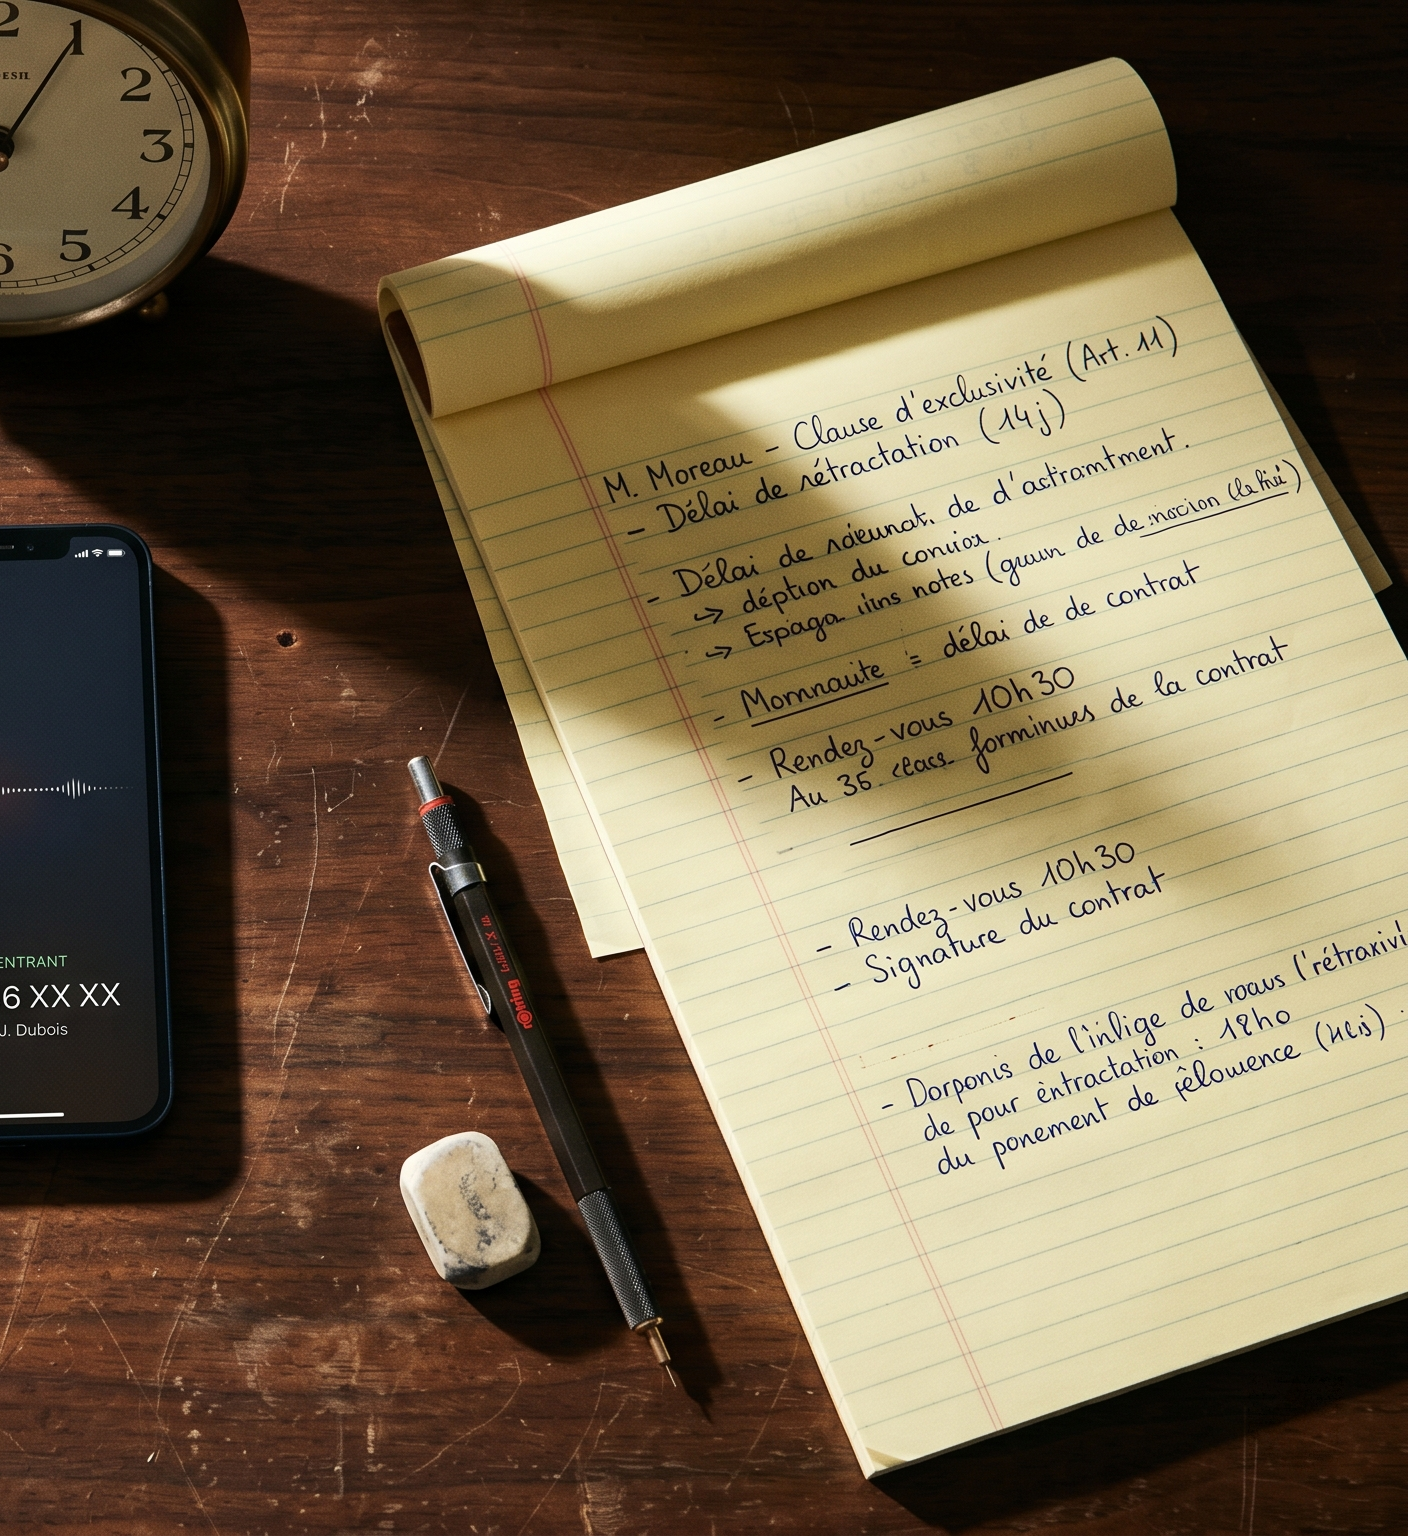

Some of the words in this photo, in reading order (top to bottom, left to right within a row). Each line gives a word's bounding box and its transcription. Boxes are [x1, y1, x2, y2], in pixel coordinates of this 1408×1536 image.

[120, 67, 152, 102] 2
[140, 128, 174, 163] 3
[111, 185, 150, 220] 4
[59, 228, 92, 262] 5
[603, 471, 638, 504] M.
[645, 452, 753, 491] Moreau
[794, 414, 883, 450] Clause
[896, 353, 1053, 423] d'exclusivité
[656, 490, 740, 533] Délai
[756, 476, 789, 504] de
[800, 433, 959, 492] rétractation
[980, 388, 1065, 444] (14j)
[672, 557, 759, 598] Délai
[779, 543, 814, 568] de
[948, 493, 980, 518] de
[851, 558, 889, 583] du
[912, 568, 974, 599] notes
[1077, 525, 1104, 549] de
[1114, 513, 1145, 537] de
[944, 620, 1010, 658] délai
[1023, 609, 1055, 634] de
[1065, 594, 1096, 621] de
[1106, 559, 1200, 608] contrat
[769, 711, 953, 779] Rendez-vous
[790, 785, 829, 812] Au
[1110, 686, 1143, 713] de
[1154, 670, 1186, 697] la
[1196, 635, 1289, 686] contrat
[849, 881, 1023, 947] Rendez-vous
[1041, 842, 1135, 887] 10h30
[865, 928, 1006, 990] Signature
[1019, 907, 1059, 936] du
[1069, 865, 1166, 919] contrat
[0, 1024, 12, 1037] J.
[16, 1022, 69, 1037] Dubois
[29, 983, 71, 1009] XX
[79, 982, 121, 1007] XX
[1029, 1041, 1061, 1070] de
[1180, 989, 1215, 1019] de
[924, 1112, 955, 1141] de
[967, 1096, 1019, 1140] pour
[938, 1145, 976, 1175] du
[1128, 1084, 1159, 1112] de
